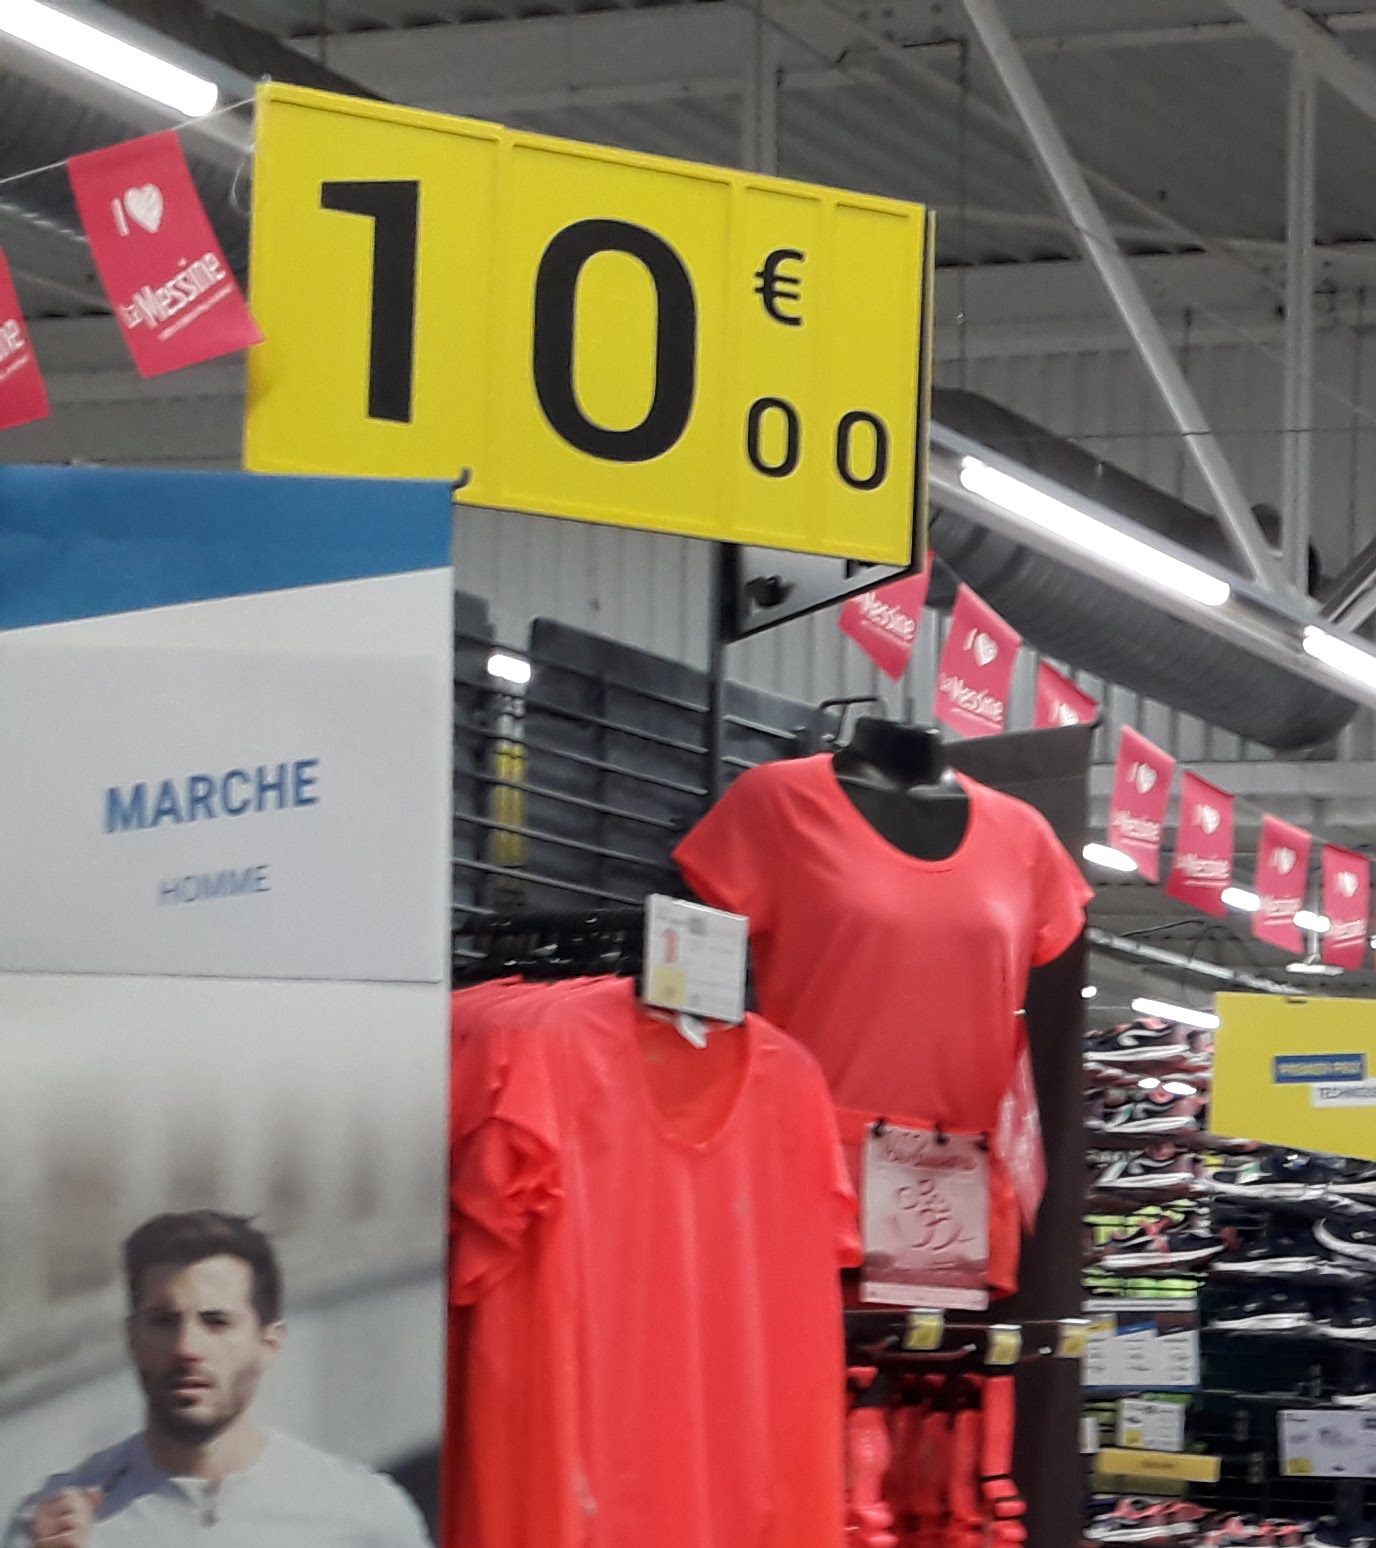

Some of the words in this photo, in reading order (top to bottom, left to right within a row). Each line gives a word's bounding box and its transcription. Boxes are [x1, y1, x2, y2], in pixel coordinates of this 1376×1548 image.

[132, 251, 226, 329] Messine
[318, 178, 700, 463] 10
[754, 249, 805, 327] €
[747, 397, 889, 492] 00
[103, 758, 320, 835] MARCHE
[159, 864, 271, 904] HOMME
